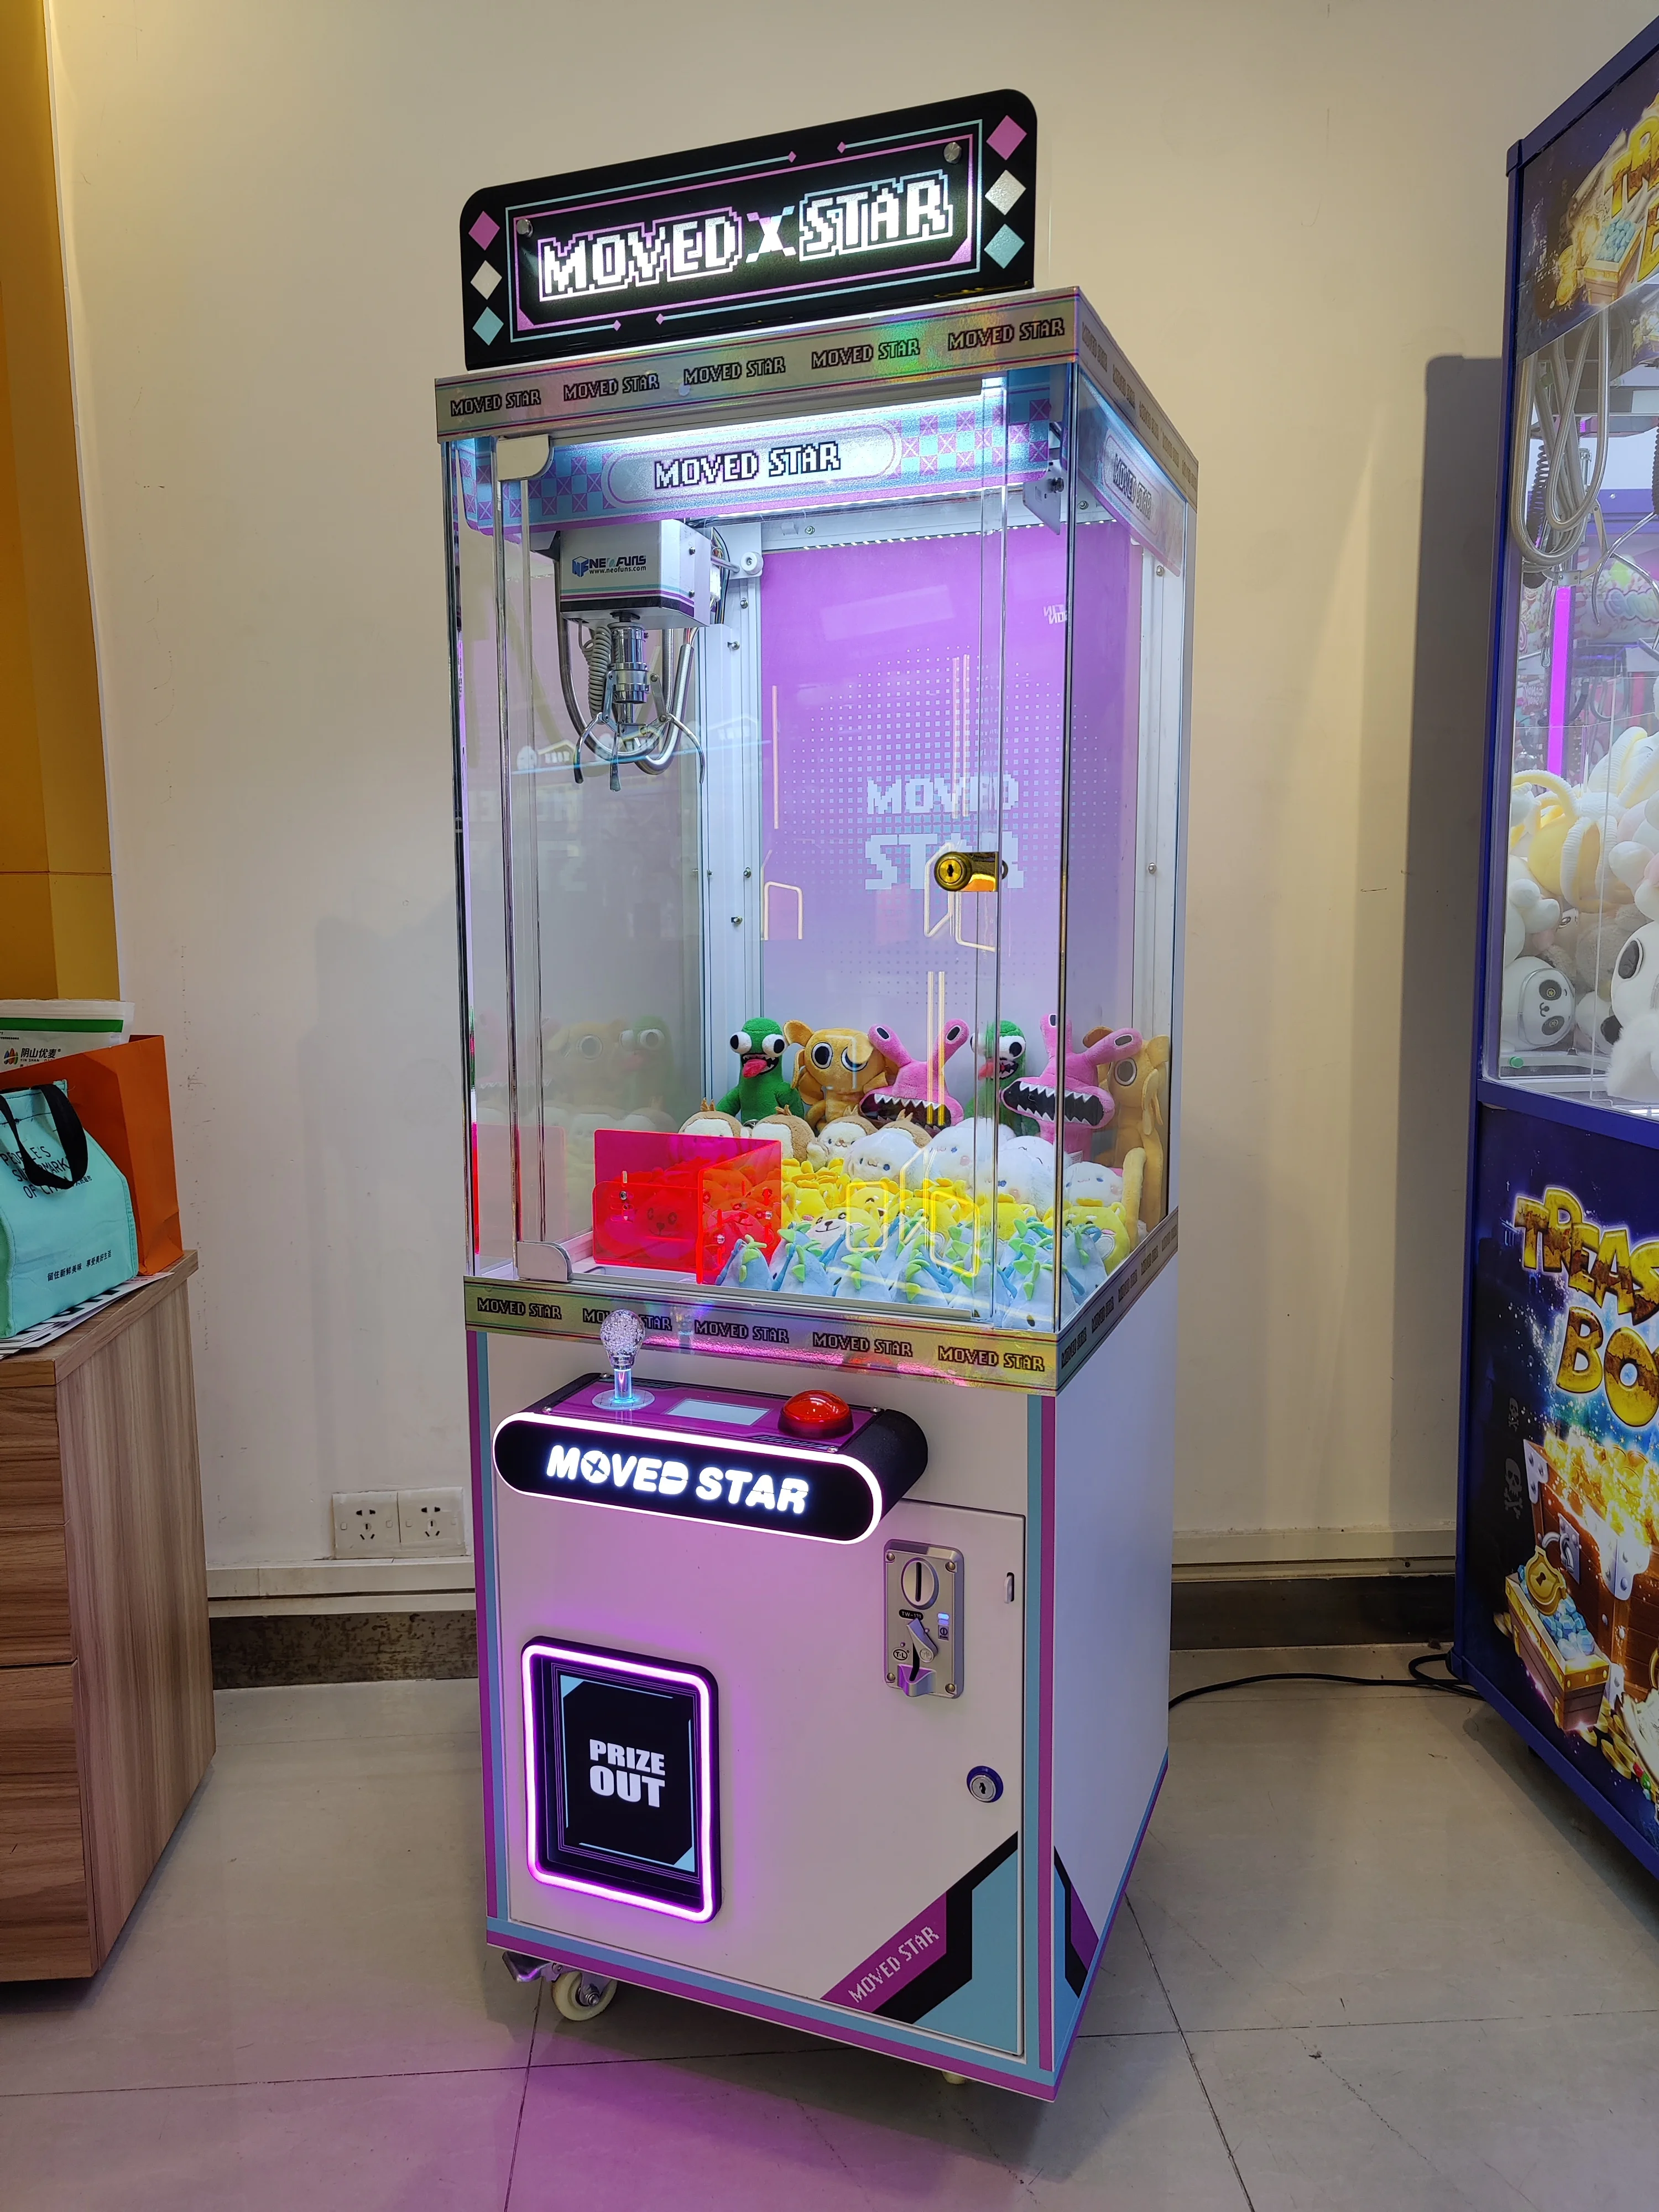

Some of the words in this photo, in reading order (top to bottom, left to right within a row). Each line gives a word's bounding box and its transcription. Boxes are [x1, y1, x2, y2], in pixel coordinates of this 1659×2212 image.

[538, 206, 743, 302] MOVED
[746, 205, 796, 263] X
[799, 169, 953, 262] STAR
[947, 324, 1015, 351] MOVED
[1019, 317, 1065, 341] STAR
[811, 344, 874, 369] MOVED
[878, 338, 921, 360] STAR
[684, 362, 743, 385] MOVED
[746, 356, 786, 377] STAR
[564, 378, 618, 401] MOVED
[622, 373, 660, 394] STAR
[451, 393, 502, 417] MOVED
[505, 389, 541, 409] STAR
[654, 450, 760, 491] MOVED
[769, 441, 841, 478] STAR
[589, 565, 646, 575] www.neofuns.com
[865, 831, 1024, 890] STR
[20, 1047, 57, 1059] 阴山优麦
[23, 1185, 37, 1199] OF
[477, 1297, 526, 1317] MOVED
[529, 1303, 562, 1321] STAR
[694, 1320, 749, 1340] MOVED
[752, 1326, 790, 1344] STAR
[812, 1332, 871, 1353] MOVED
[874, 1339, 913, 1358] STAR
[938, 1345, 999, 1367] MOVED
[1003, 1353, 1045, 1373] STAR
[546, 1444, 689, 1495] MOVED
[695, 1467, 810, 1515] STAR
[589, 1738, 666, 1776] PRIZE
[589, 1765, 666, 1808] OUT
[847, 1951, 901, 2004] MOVED
[897, 1925, 940, 1962] STAR
